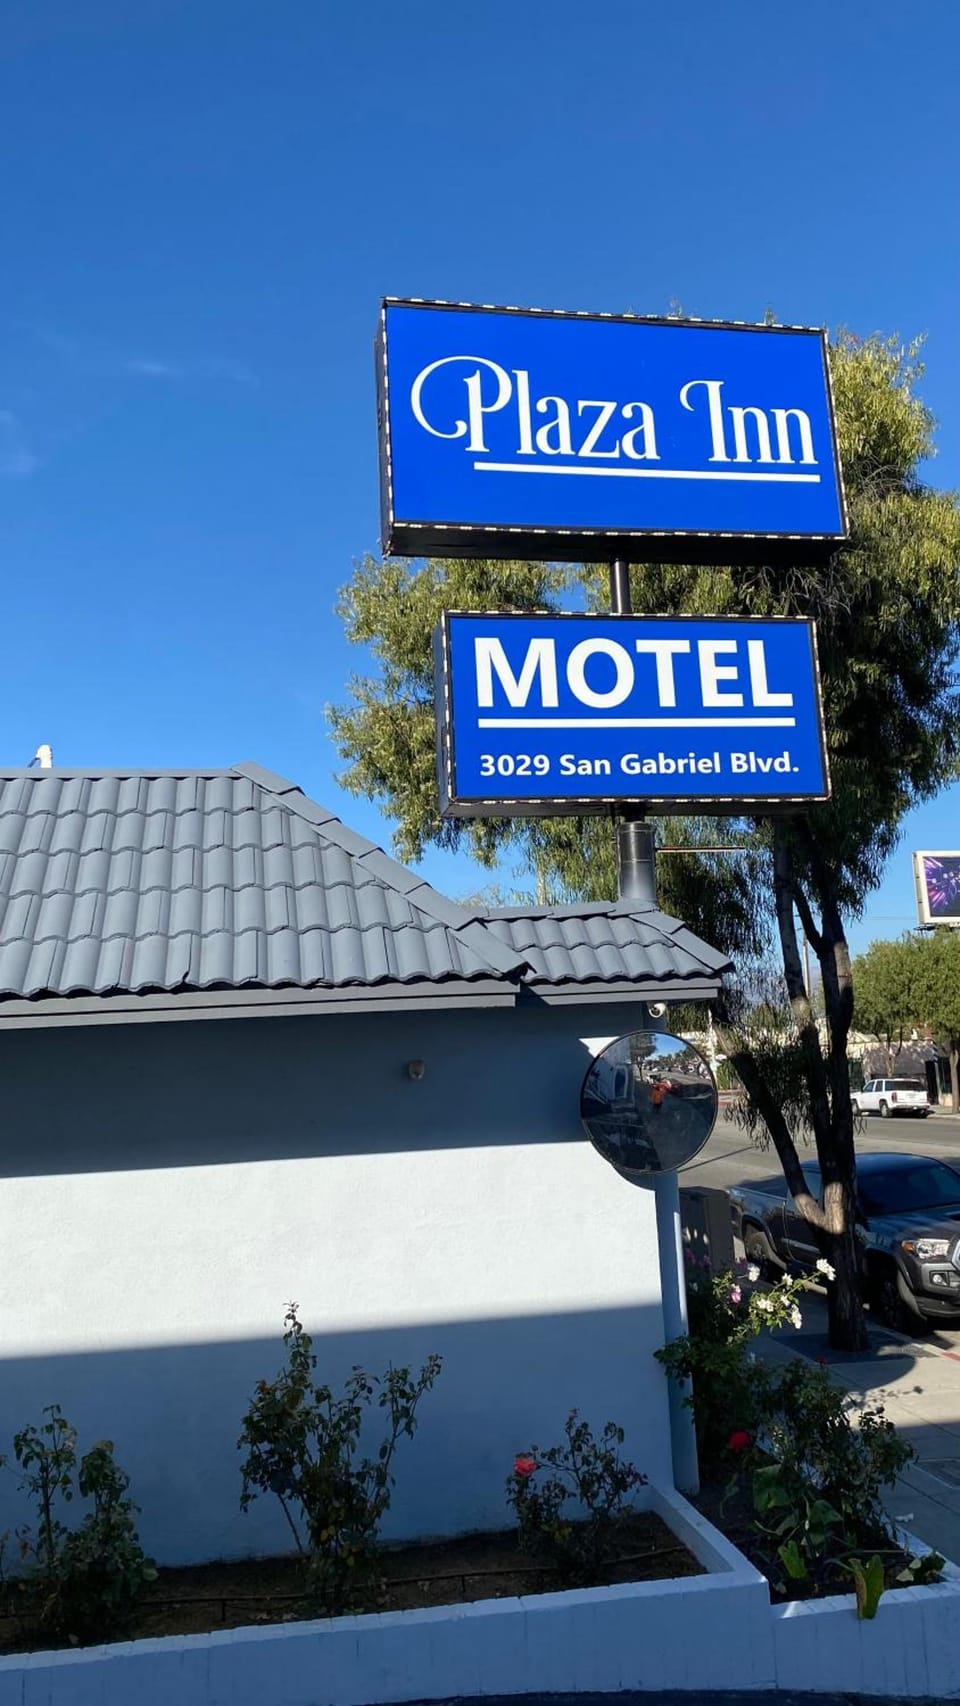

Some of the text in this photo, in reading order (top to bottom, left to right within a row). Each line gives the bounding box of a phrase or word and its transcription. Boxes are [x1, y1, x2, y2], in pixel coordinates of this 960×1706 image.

[411, 356, 818, 465] Plaza Inn
[475, 637, 793, 708] MOTEL
[480, 751, 799, 776] 3029 San Gabriel Blvd.
